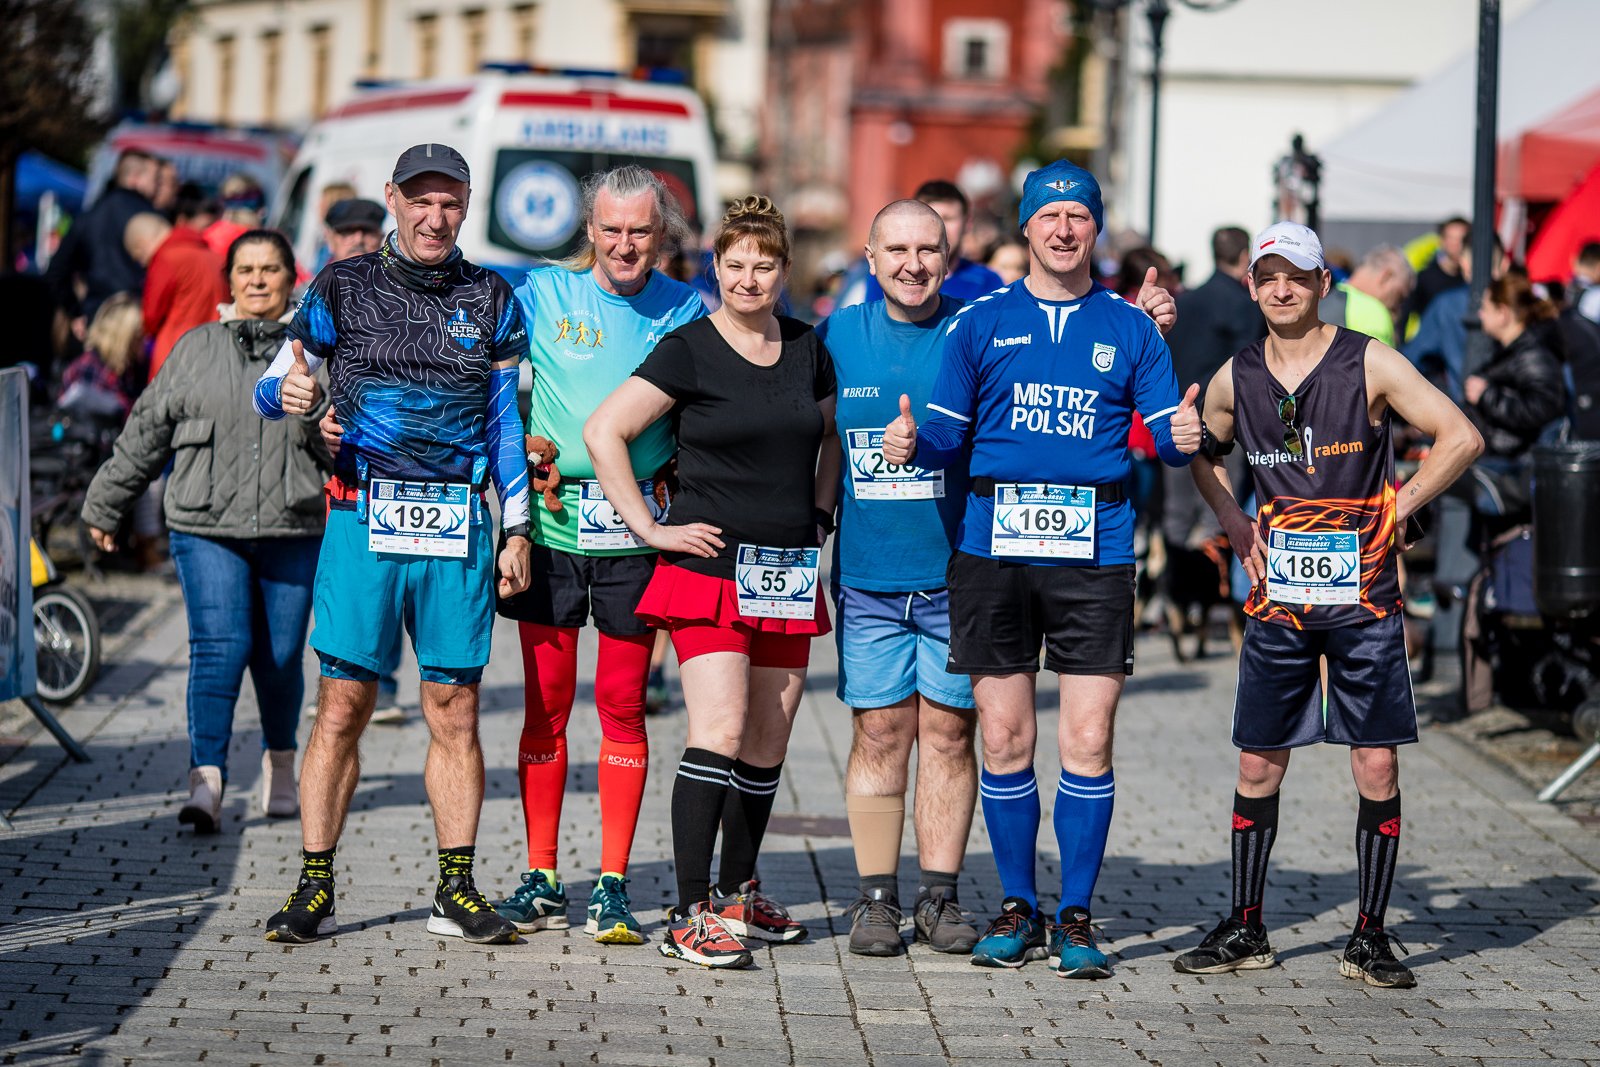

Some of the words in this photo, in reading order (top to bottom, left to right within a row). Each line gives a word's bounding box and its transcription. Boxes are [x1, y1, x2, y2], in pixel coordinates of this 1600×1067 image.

[447, 326, 481, 334] ULTRA
[450, 332, 481, 340] RACE
[993, 333, 1032, 348] hummel
[849, 386, 880, 398] BRITA
[1013, 382, 1100, 414] MISTRZ
[1010, 406, 1096, 440] POLSKI
[1314, 440, 1364, 458] radom
[395, 505, 441, 529] 192
[1019, 508, 1067, 532] 169
[1286, 555, 1332, 579] 186
[760, 569, 787, 593] 55
[607, 754, 642, 765] ROYAL
